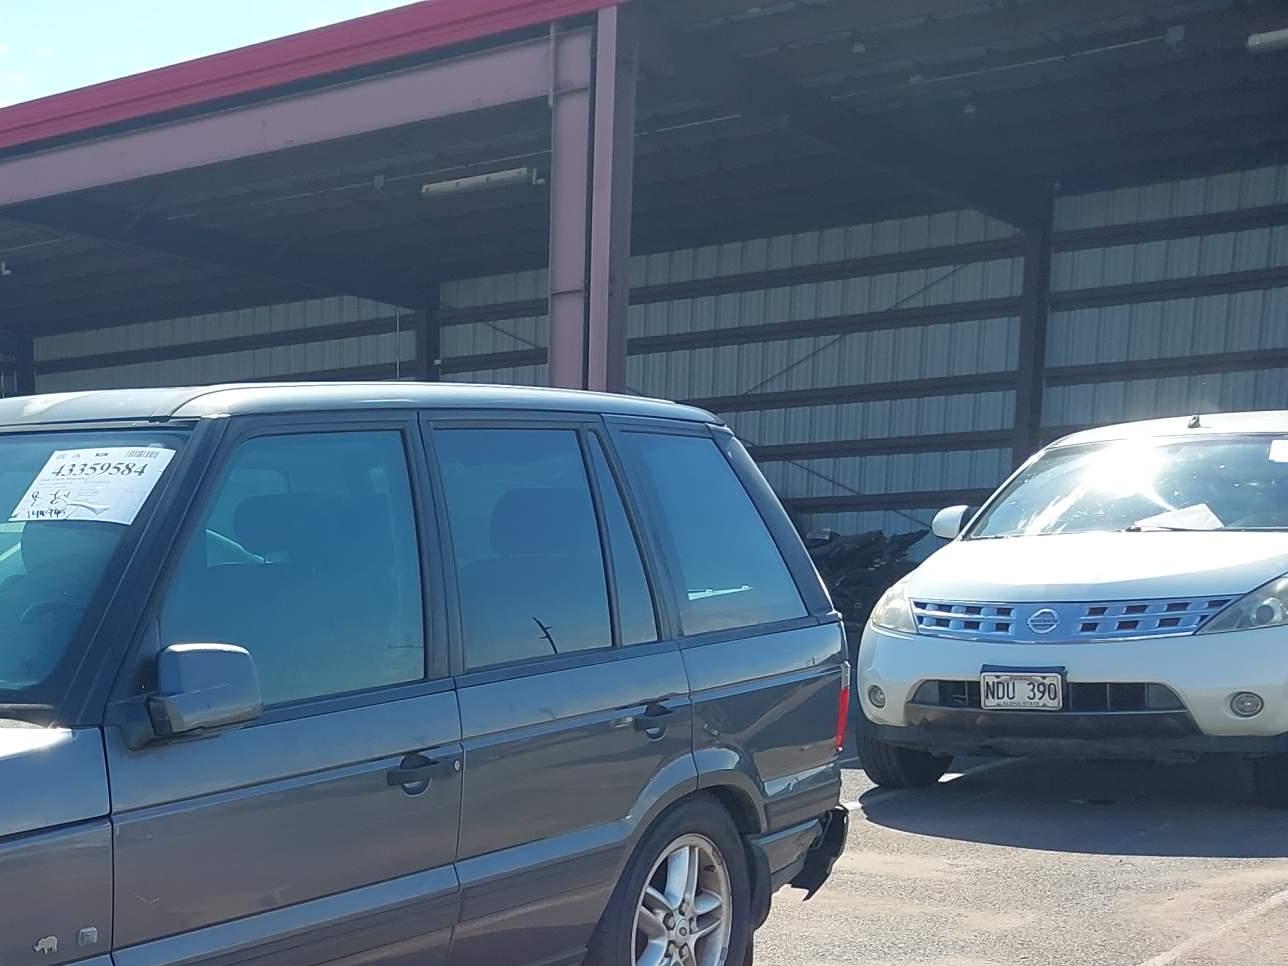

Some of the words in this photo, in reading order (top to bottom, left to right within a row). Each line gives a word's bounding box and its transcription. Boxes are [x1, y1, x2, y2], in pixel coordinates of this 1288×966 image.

[51, 462, 149, 478] 43359584
[985, 681, 1016, 700] NDU
[1027, 682, 1058, 701] 390
